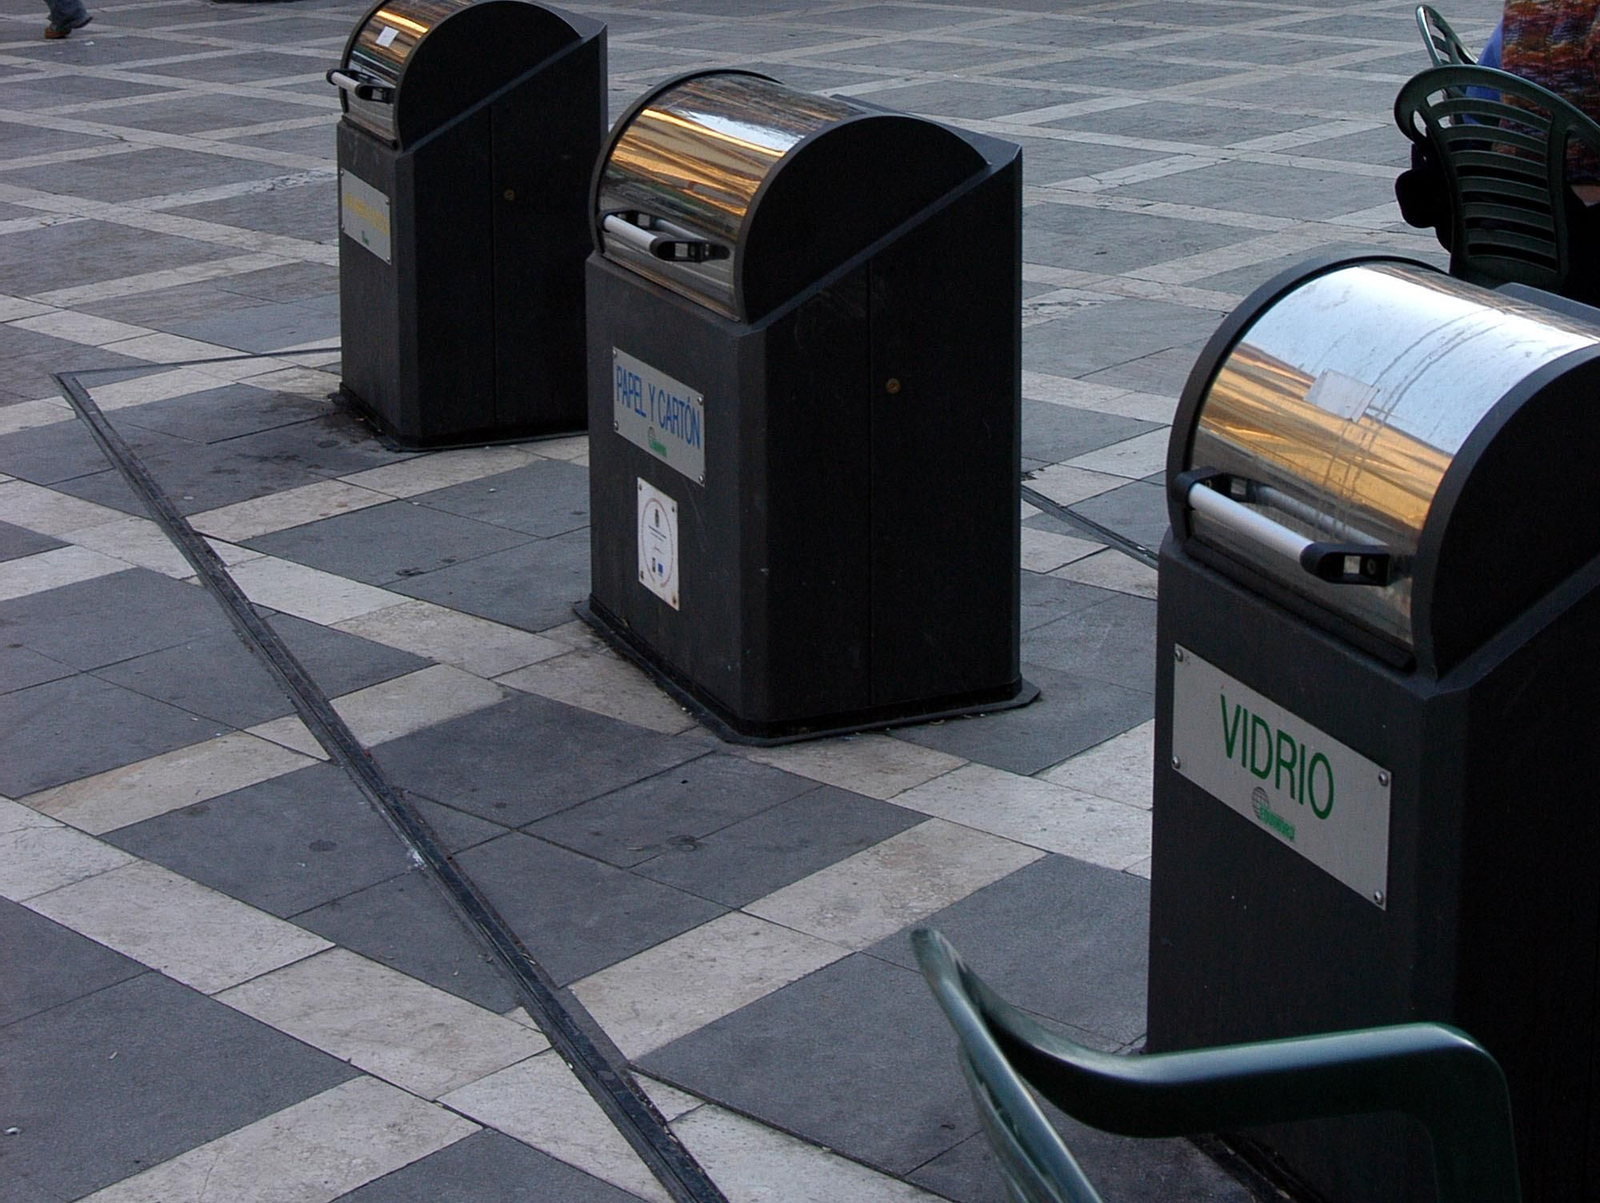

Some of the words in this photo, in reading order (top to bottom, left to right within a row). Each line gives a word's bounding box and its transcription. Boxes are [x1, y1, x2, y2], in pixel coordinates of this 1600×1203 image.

[615, 364, 647, 418] PAPEL
[648, 383, 656, 423] Y
[657, 396, 701, 449] CARTÓN
[1220, 693, 1335, 820] VIDRIO
